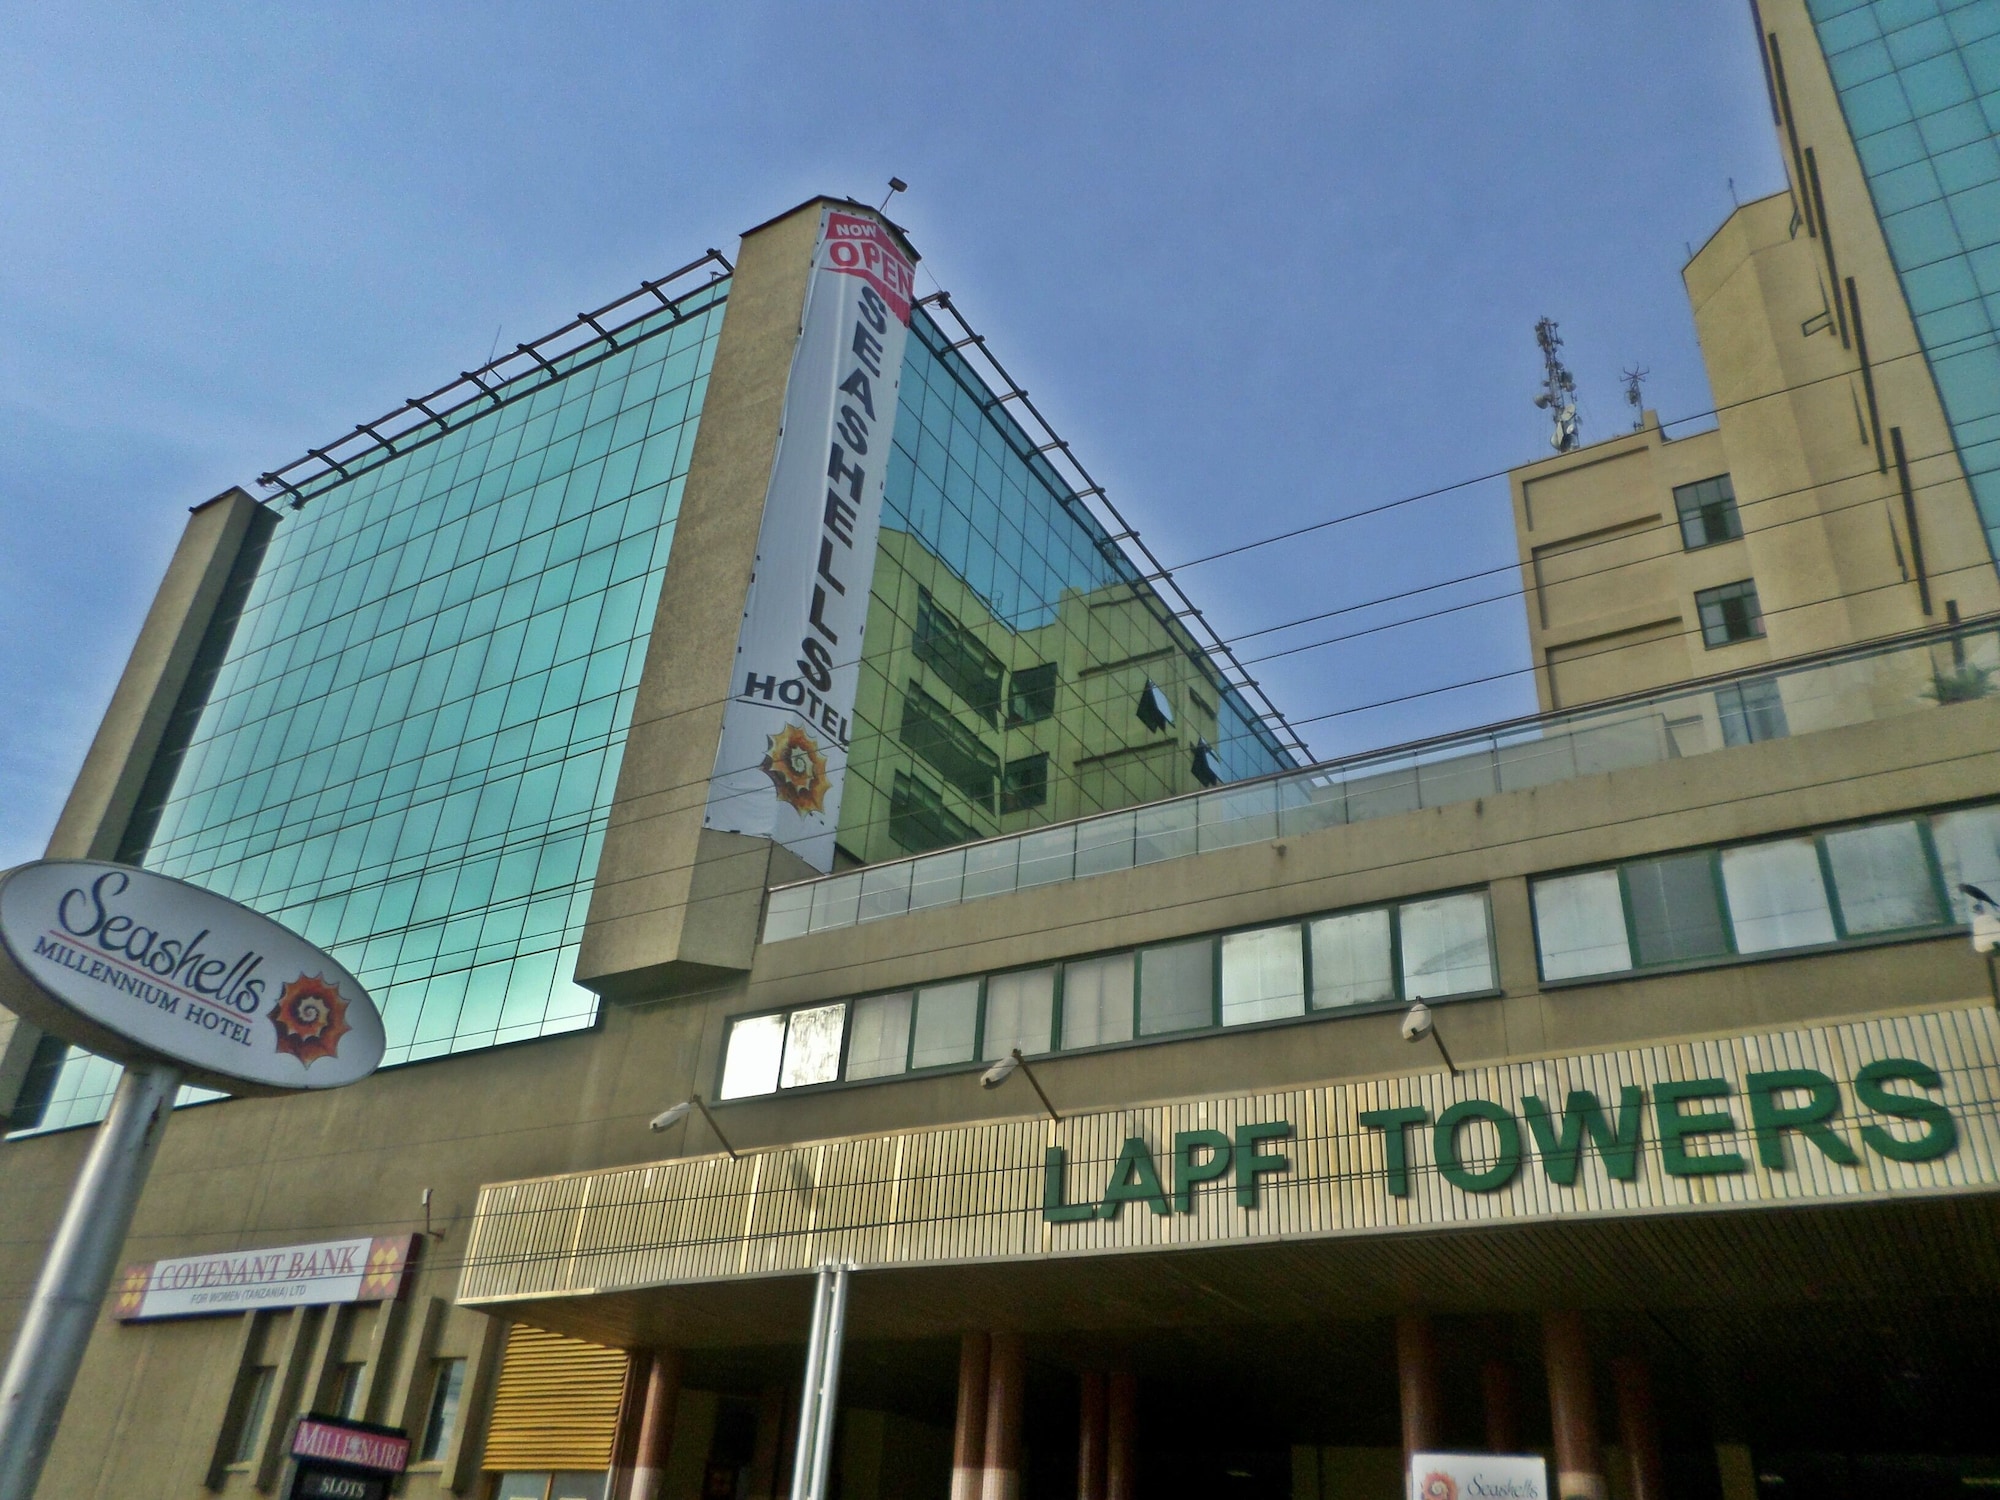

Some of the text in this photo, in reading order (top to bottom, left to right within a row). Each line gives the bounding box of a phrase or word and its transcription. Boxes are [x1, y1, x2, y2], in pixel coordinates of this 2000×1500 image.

[836, 223, 876, 238] NOW
[829, 241, 915, 302] OPEN
[796, 286, 889, 693] SEASHELLS
[743, 671, 849, 747] HOTEL
[59, 871, 266, 1014] Seashells
[33, 935, 252, 1047] MILLENNIUM HOTEL
[1044, 1058, 1960, 1223] LAPF TOWERS
[157, 1245, 361, 1290] COVENANT BANK
[190, 1293, 208, 1305] FOR
[209, 1290, 241, 1303] WOMEN
[289, 1284, 307, 1297] LTD
[321, 1477, 367, 1498] SLOTS
[1467, 1473, 1538, 1498] Seashells
